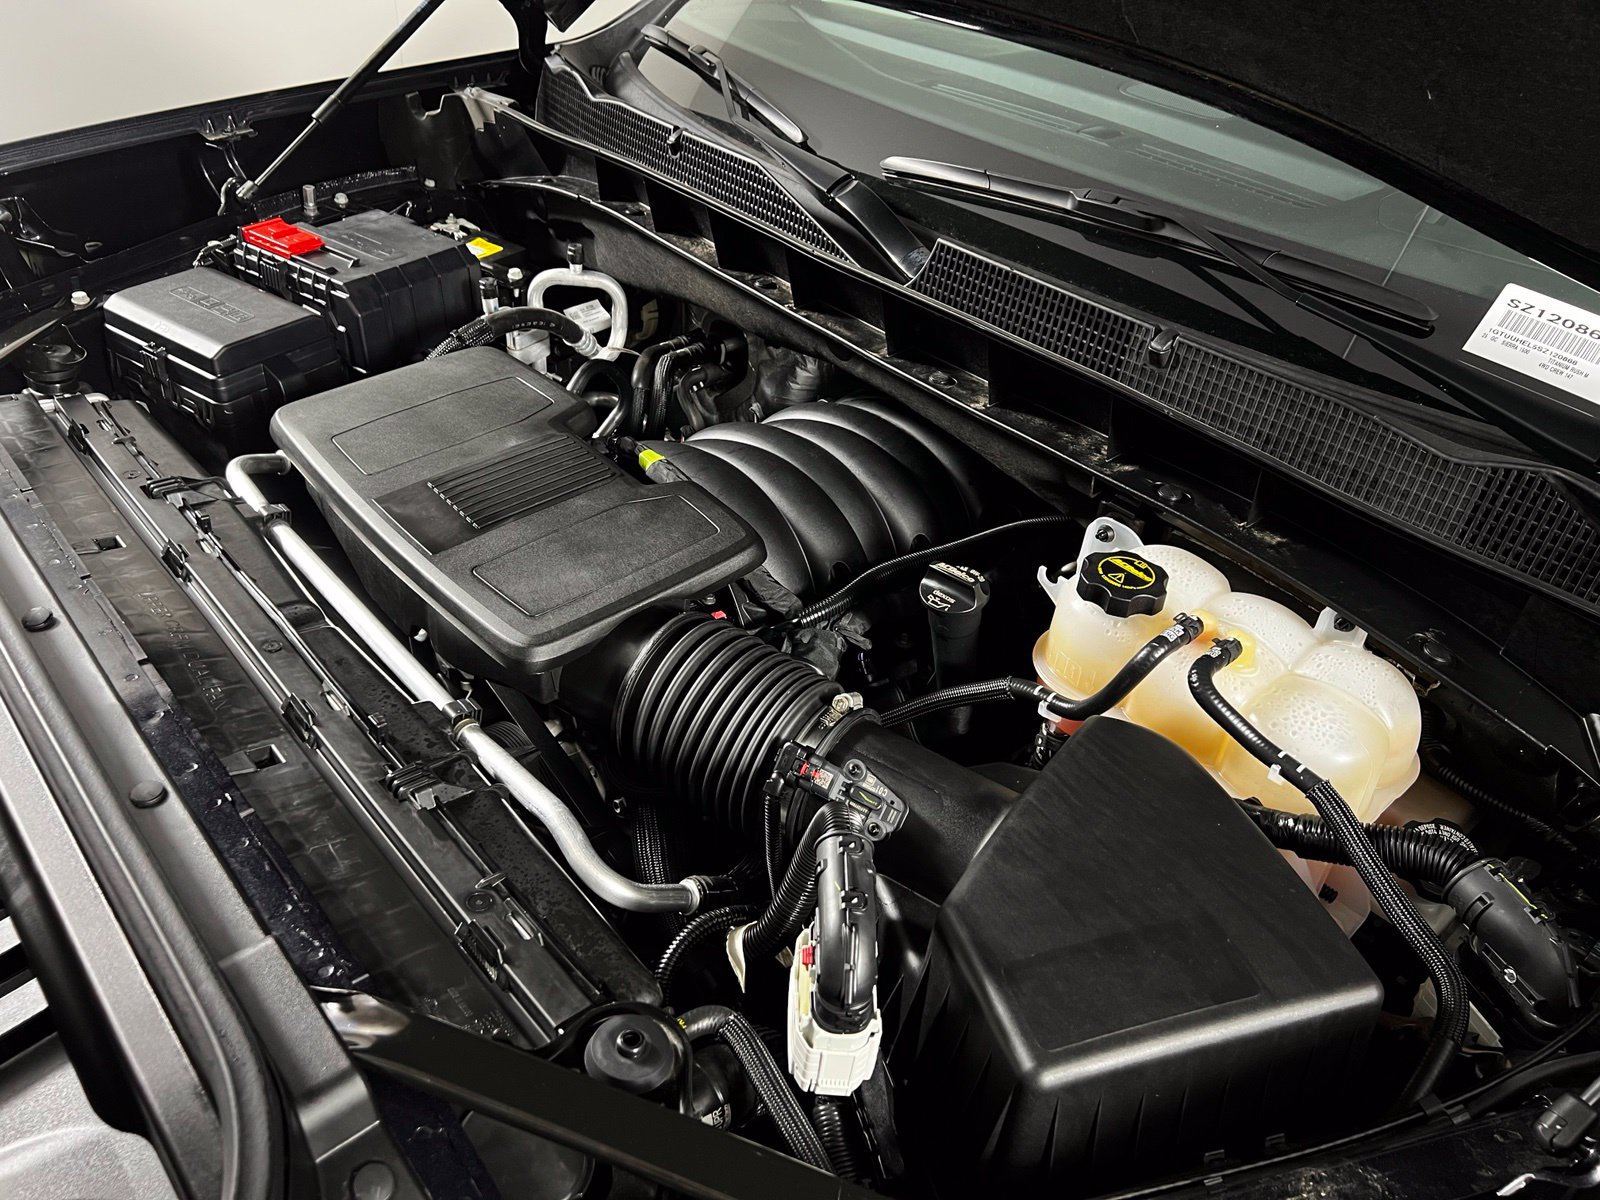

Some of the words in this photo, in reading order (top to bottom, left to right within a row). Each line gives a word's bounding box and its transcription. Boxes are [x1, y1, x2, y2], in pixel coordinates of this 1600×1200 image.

[1549, 366, 1564, 376] CREW
[932, 562, 975, 583] ACDelco
[933, 590, 956, 604] dexos
